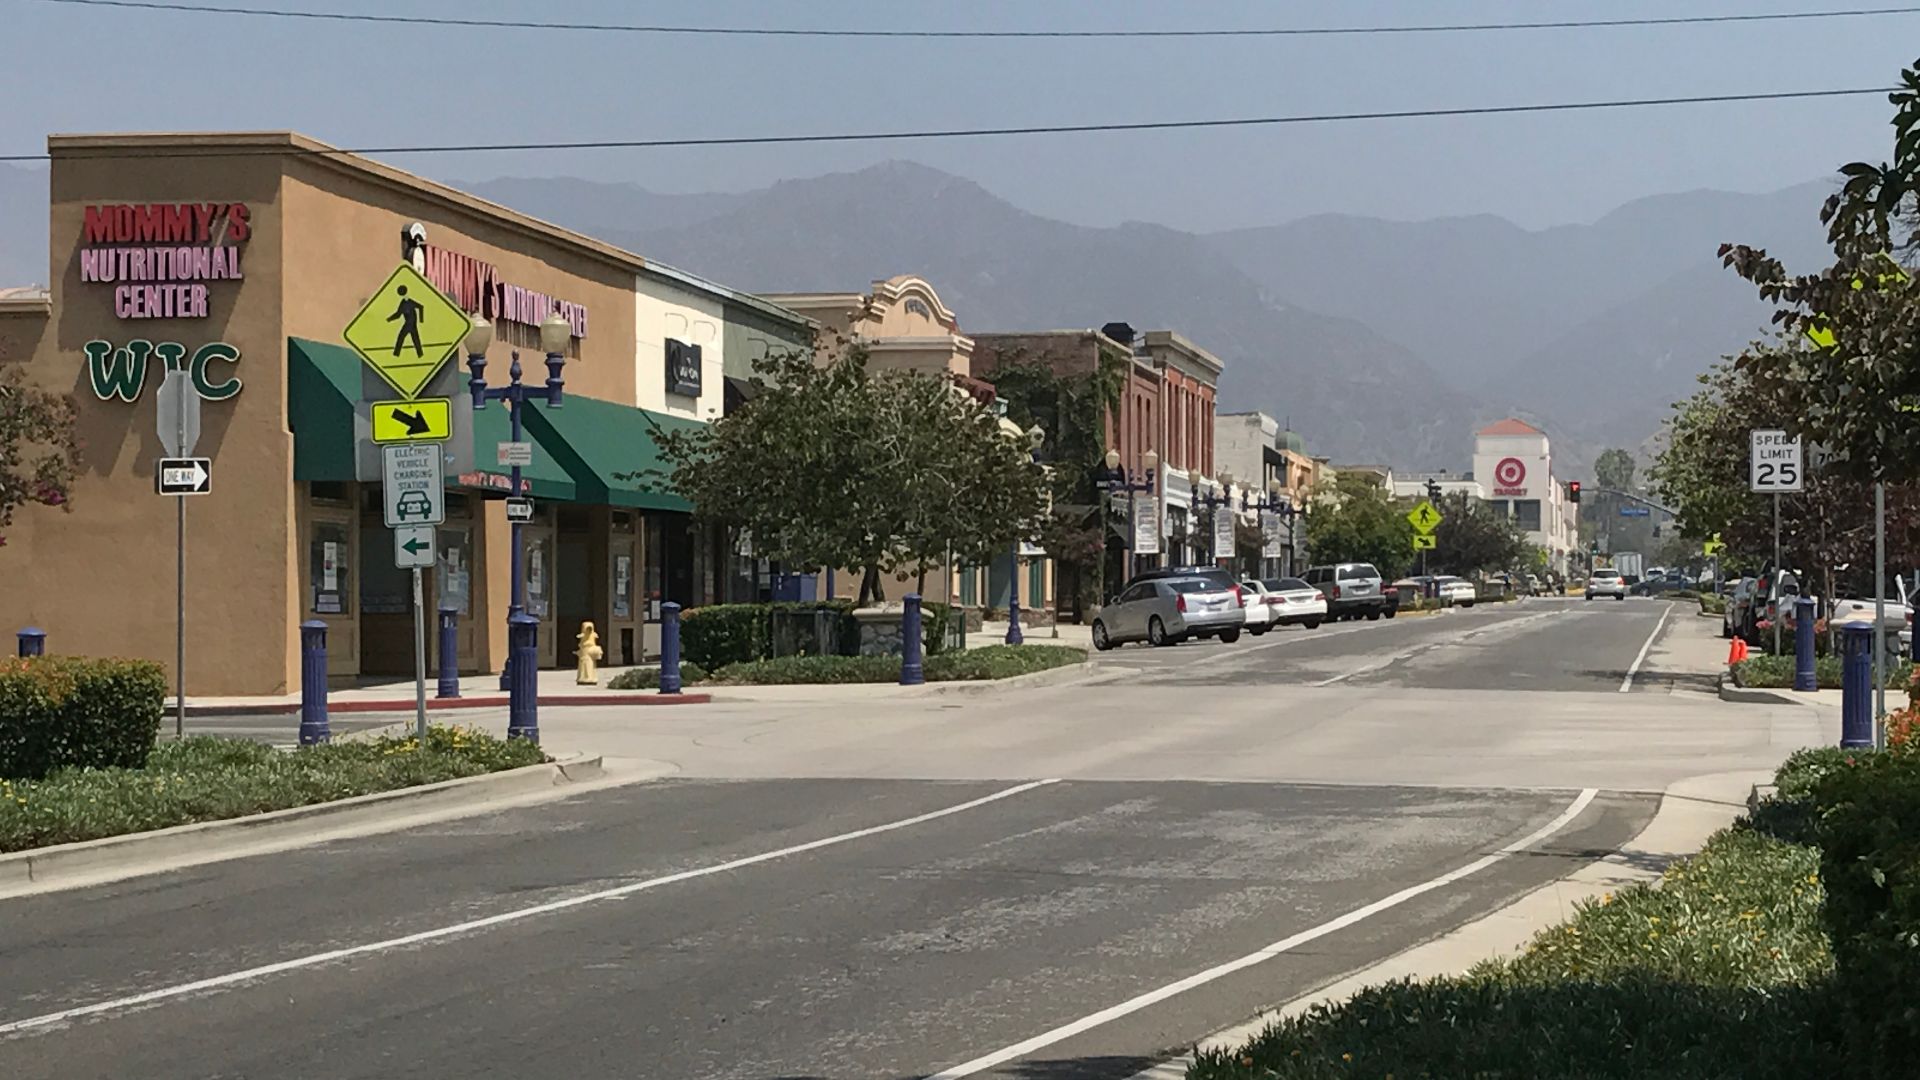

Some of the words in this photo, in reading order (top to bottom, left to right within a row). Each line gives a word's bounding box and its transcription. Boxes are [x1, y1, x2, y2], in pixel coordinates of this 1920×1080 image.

[85, 203, 250, 243] MOMMY'S
[81, 246, 243, 282] NUTRITIONAL
[115, 284, 208, 319] CENTER
[1760, 449, 1793, 459] LIMIT
[397, 459, 428, 469] VEHICLE
[165, 470, 179, 483] ONE
[394, 469, 433, 480] CHARGING
[1757, 463, 1797, 485] 25
[398, 481, 430, 491] STATION
[1493, 488, 1528, 497] TARGET
